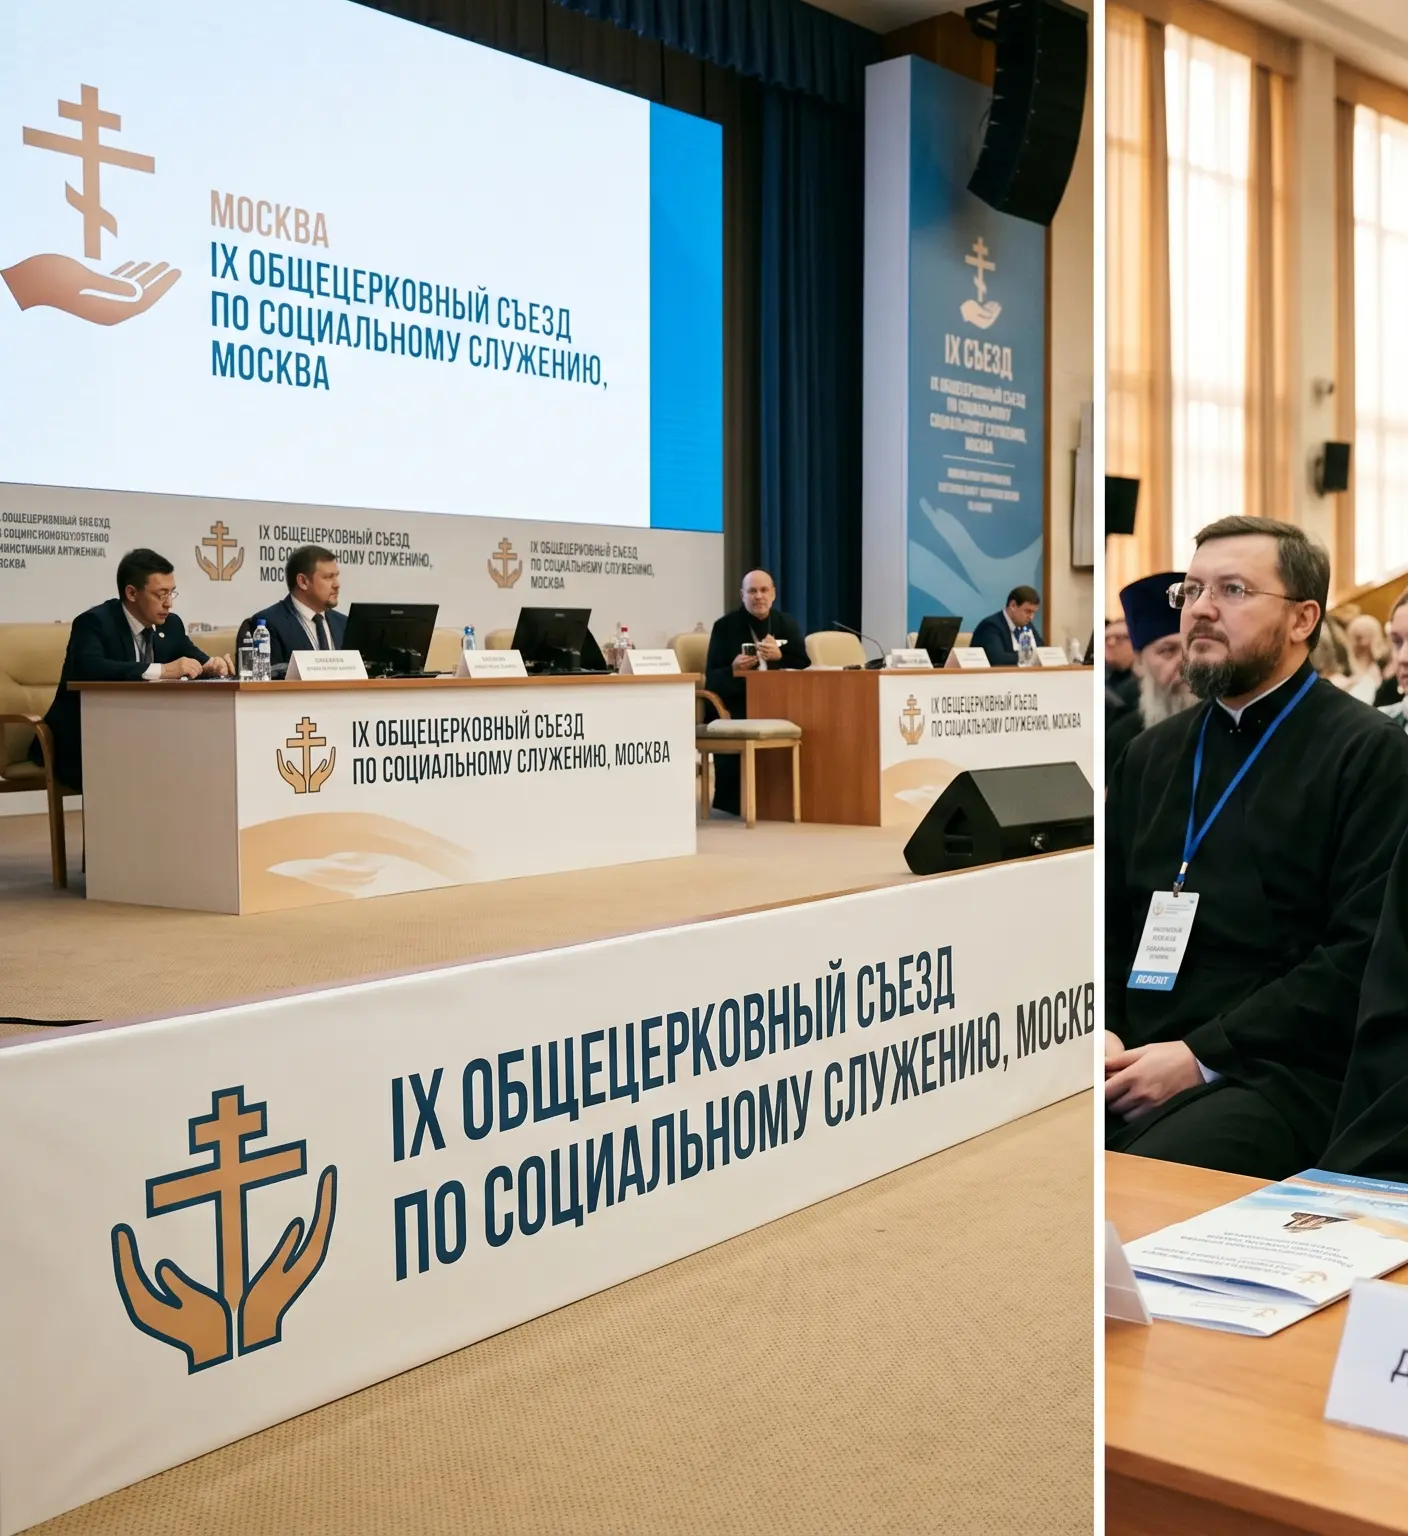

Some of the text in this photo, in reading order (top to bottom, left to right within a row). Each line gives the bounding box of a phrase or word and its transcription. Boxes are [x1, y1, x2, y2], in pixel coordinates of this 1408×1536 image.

[211, 189, 329, 248] МОСКВА
[211, 242, 571, 343] IX ОБЩЕЦЕРКОВНЫЙ СЪЕЗД
[211, 291, 608, 391] ПО СОЦИАЛЬНОМУ СЛУЖЕНИЮ,
[211, 340, 330, 390] МОСКВА
[945, 334, 1013, 382] IX СЪЕЗД
[259, 525, 410, 549] IX ОБЩЕЦЕРКОВНЫЙ СЪЕЗД
[260, 546, 274, 561] ПО
[352, 710, 584, 748] IX ОБЩЕЦЕРКОВНЫЙ СЪЕЗД
[931, 720, 942, 737] ПО
[353, 740, 670, 784] ПО СОЦИАЛЬНОМУ СЛУЖЕНИЮ, МОСКВА
[391, 945, 955, 1162] IX ОБЩЕЦЕРКОВНЫЙ СЪЕЗД
[394, 1180, 468, 1281] ПО
[484, 1070, 813, 1248] СОЦИАЛЬНОМУ
[824, 1012, 1009, 1127] СЛУЖЕНИЮ,
